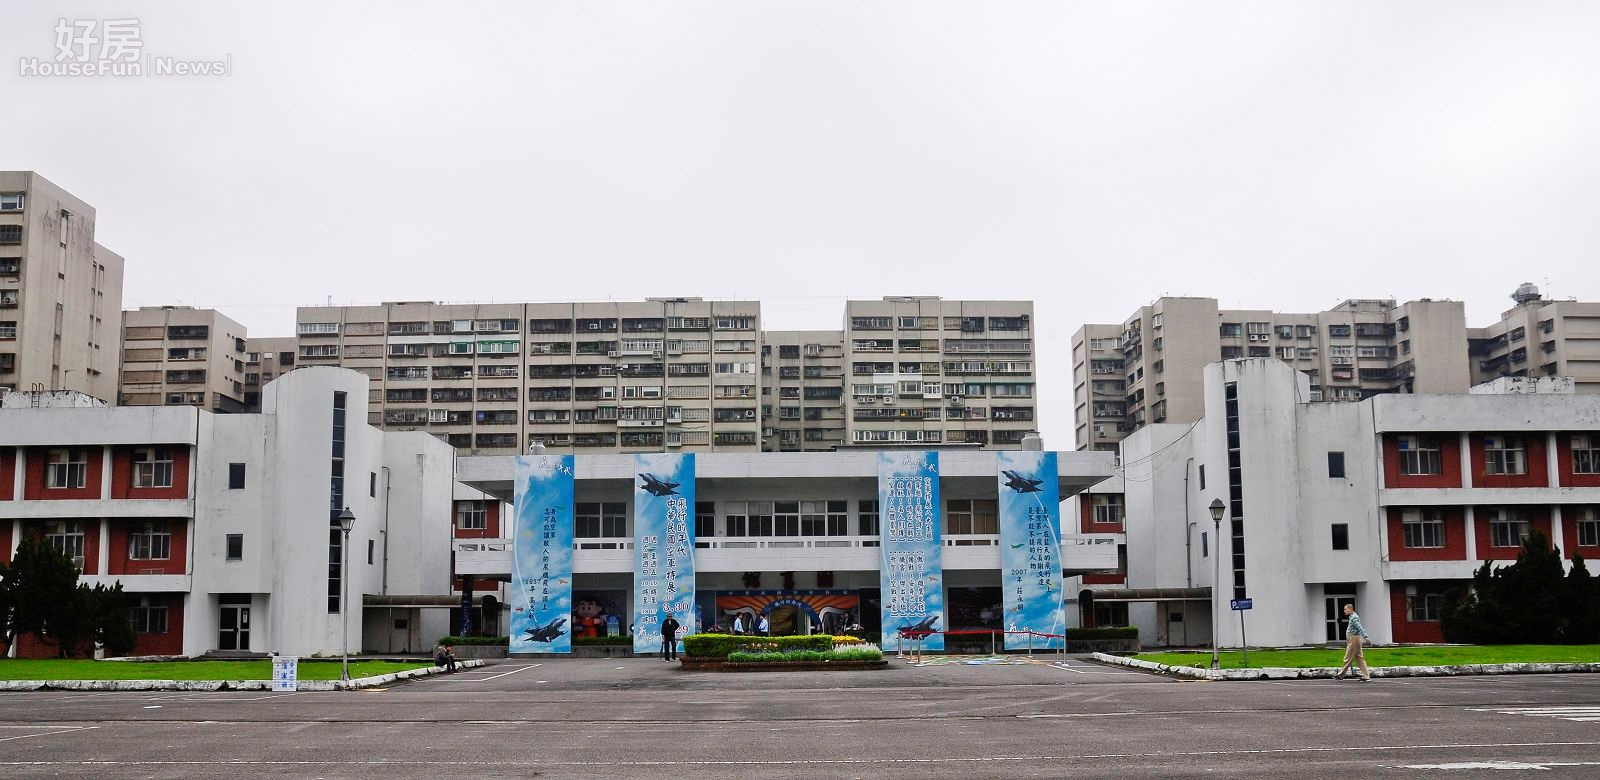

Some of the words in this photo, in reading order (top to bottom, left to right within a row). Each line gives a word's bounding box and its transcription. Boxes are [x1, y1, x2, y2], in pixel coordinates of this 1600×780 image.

[666, 499, 677, 592] 中華民國空軍特展
[677, 498, 687, 556] 飛行的年代
[1028, 507, 1037, 570] 是不能不提的人物
[663, 602, 689, 612] 3.30
